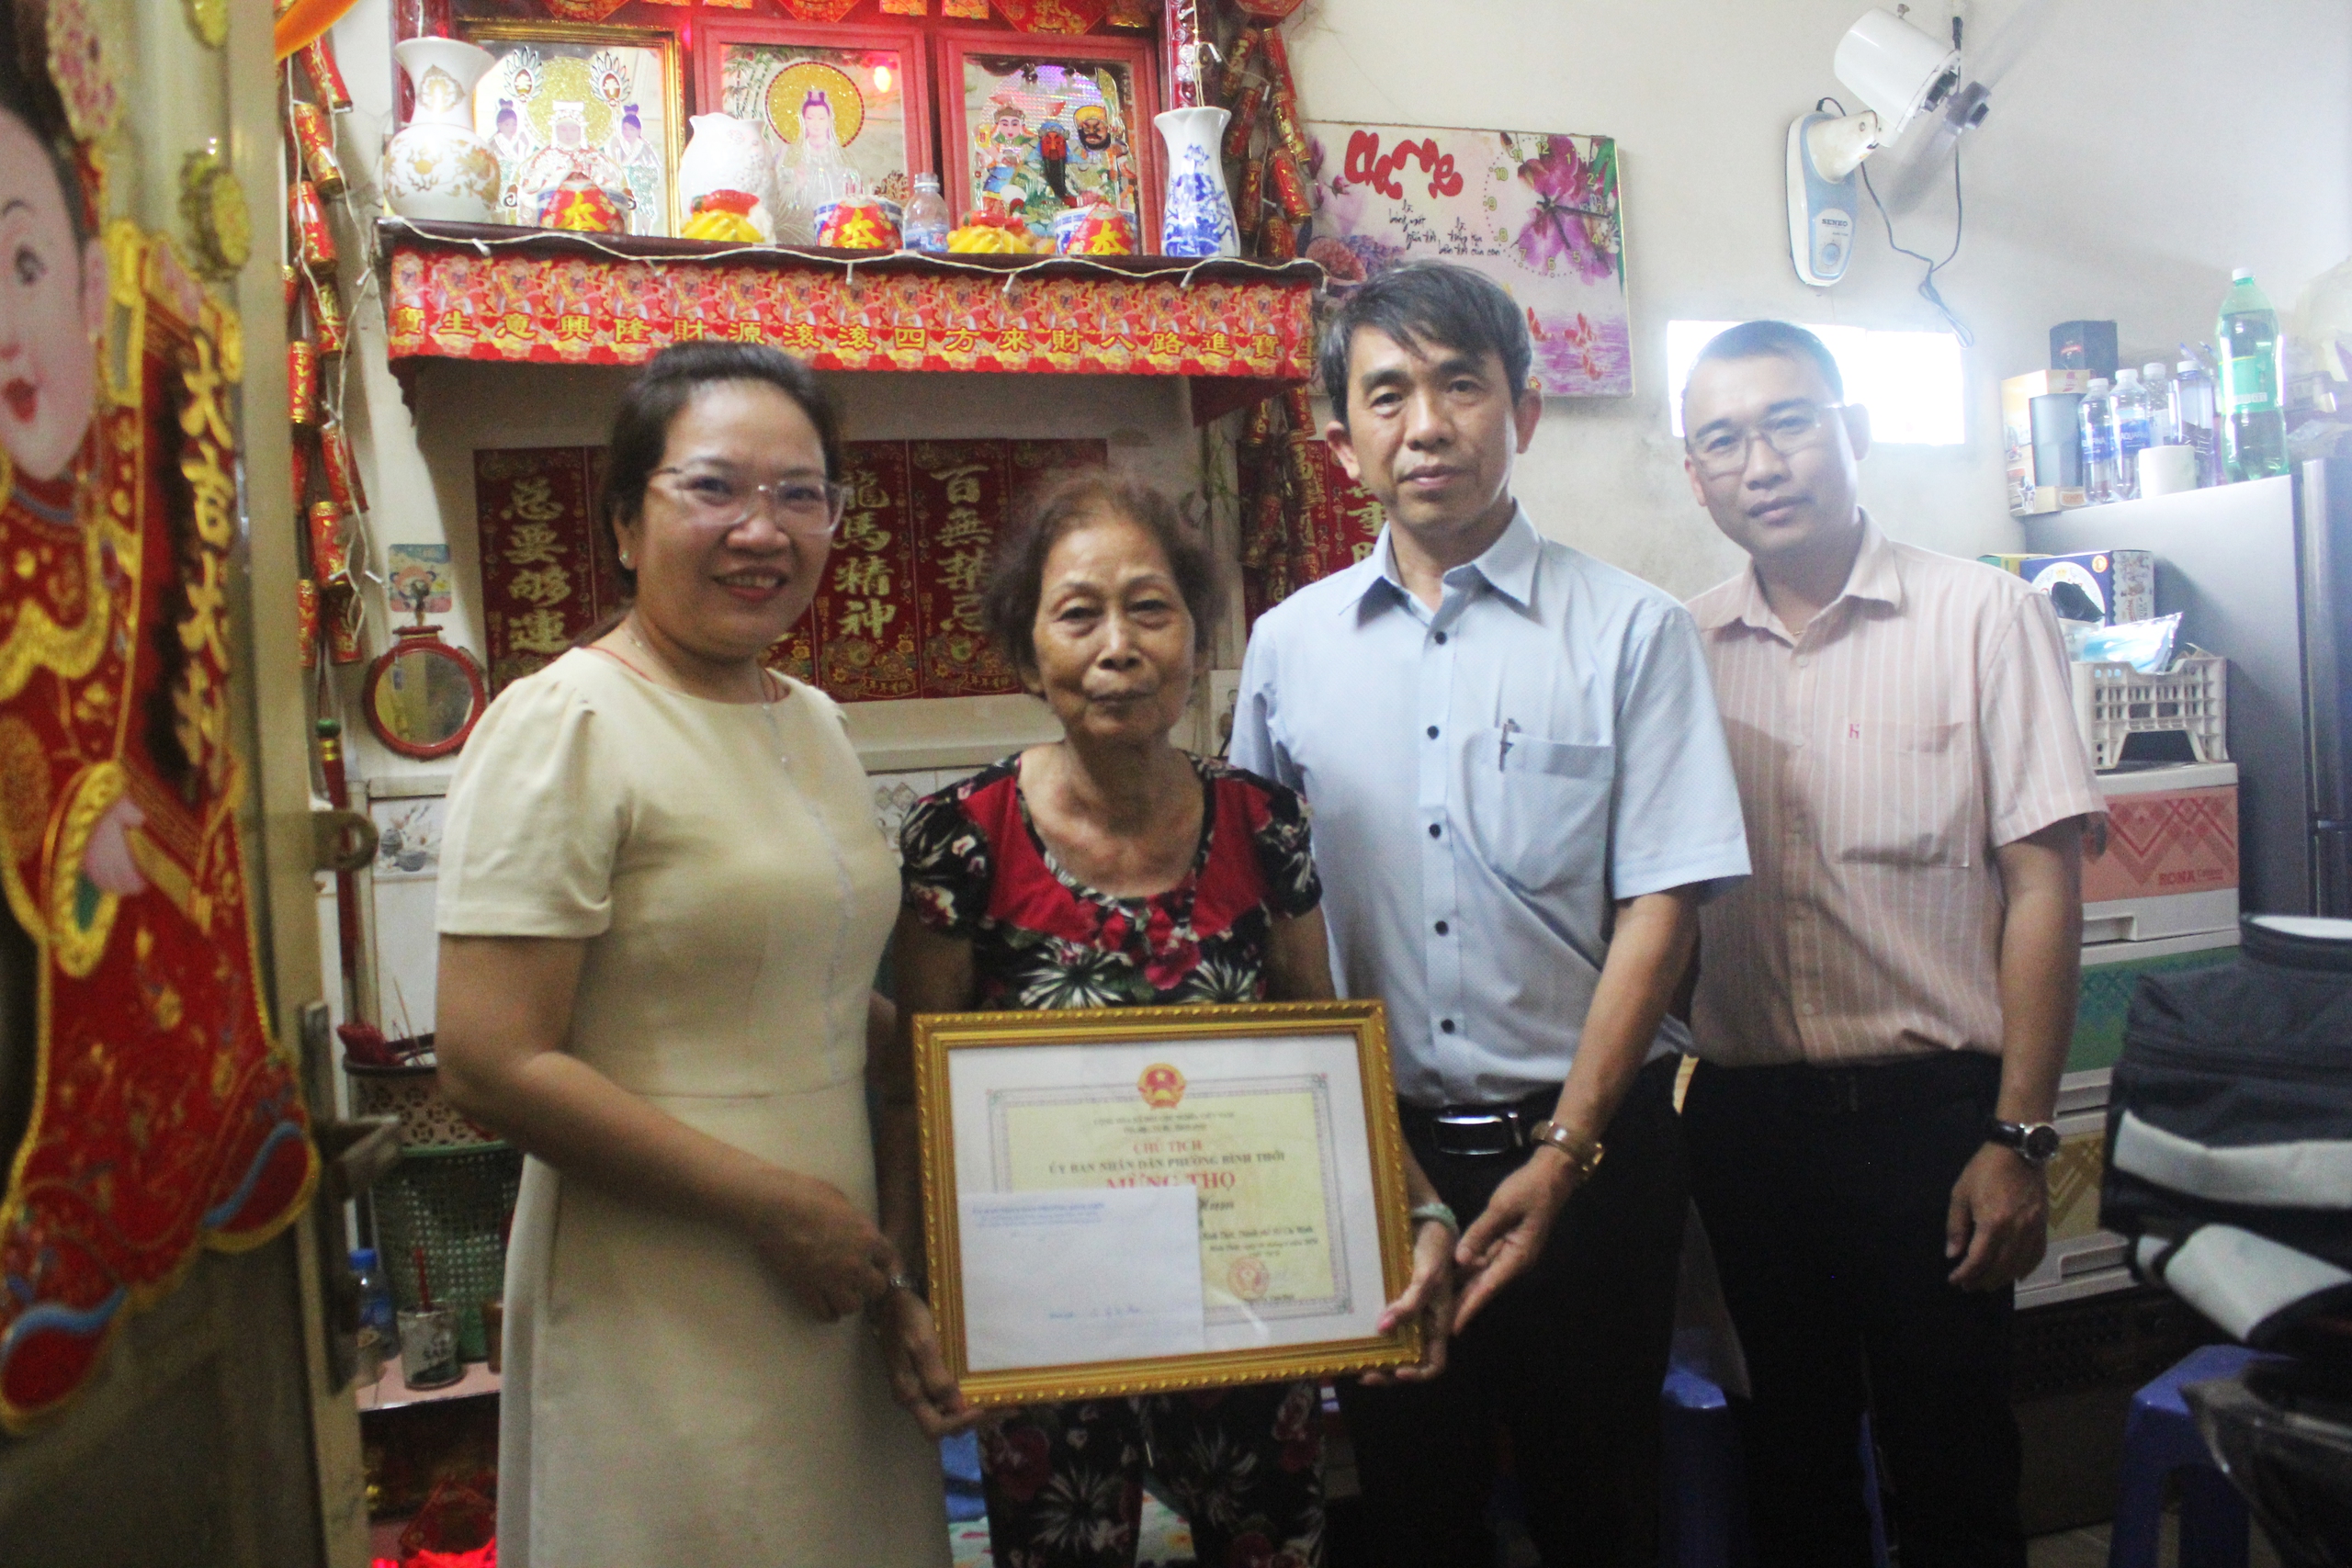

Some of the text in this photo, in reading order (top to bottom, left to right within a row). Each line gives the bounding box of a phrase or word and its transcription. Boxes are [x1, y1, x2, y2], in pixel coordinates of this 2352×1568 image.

[1535, 141, 1550, 155] 12
[1512, 149, 1523, 163] 11
[1566, 152, 1572, 165] 1
[1494, 167, 1508, 181] 10
[1587, 173, 1594, 186] 2
[1487, 197, 1497, 211] 9
[1498, 227, 1508, 243] 8
[1592, 234, 1599, 245] 4
[1519, 249, 1527, 262] 7
[1573, 251, 1581, 263] 5
[1547, 257, 1556, 270] 6
